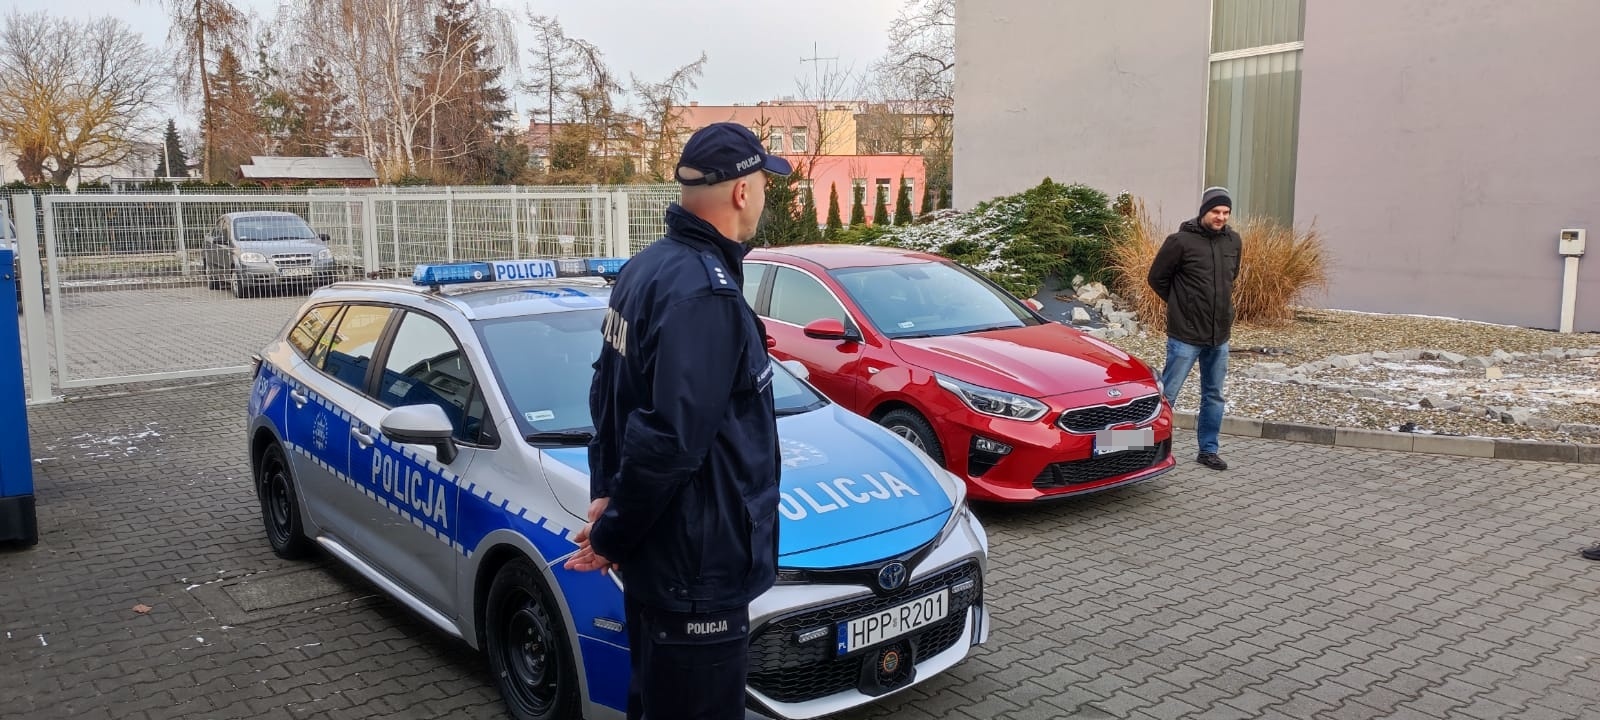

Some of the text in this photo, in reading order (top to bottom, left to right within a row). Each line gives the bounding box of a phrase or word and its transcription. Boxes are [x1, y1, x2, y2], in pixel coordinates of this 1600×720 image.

[736, 154, 761, 171] POLICJA
[497, 263, 554, 280] POLICJA
[372, 447, 448, 529] POLICJA
[778, 471, 920, 521] OLICJA
[687, 620, 728, 634] POLICJA
[852, 593, 943, 648] HPP R201
